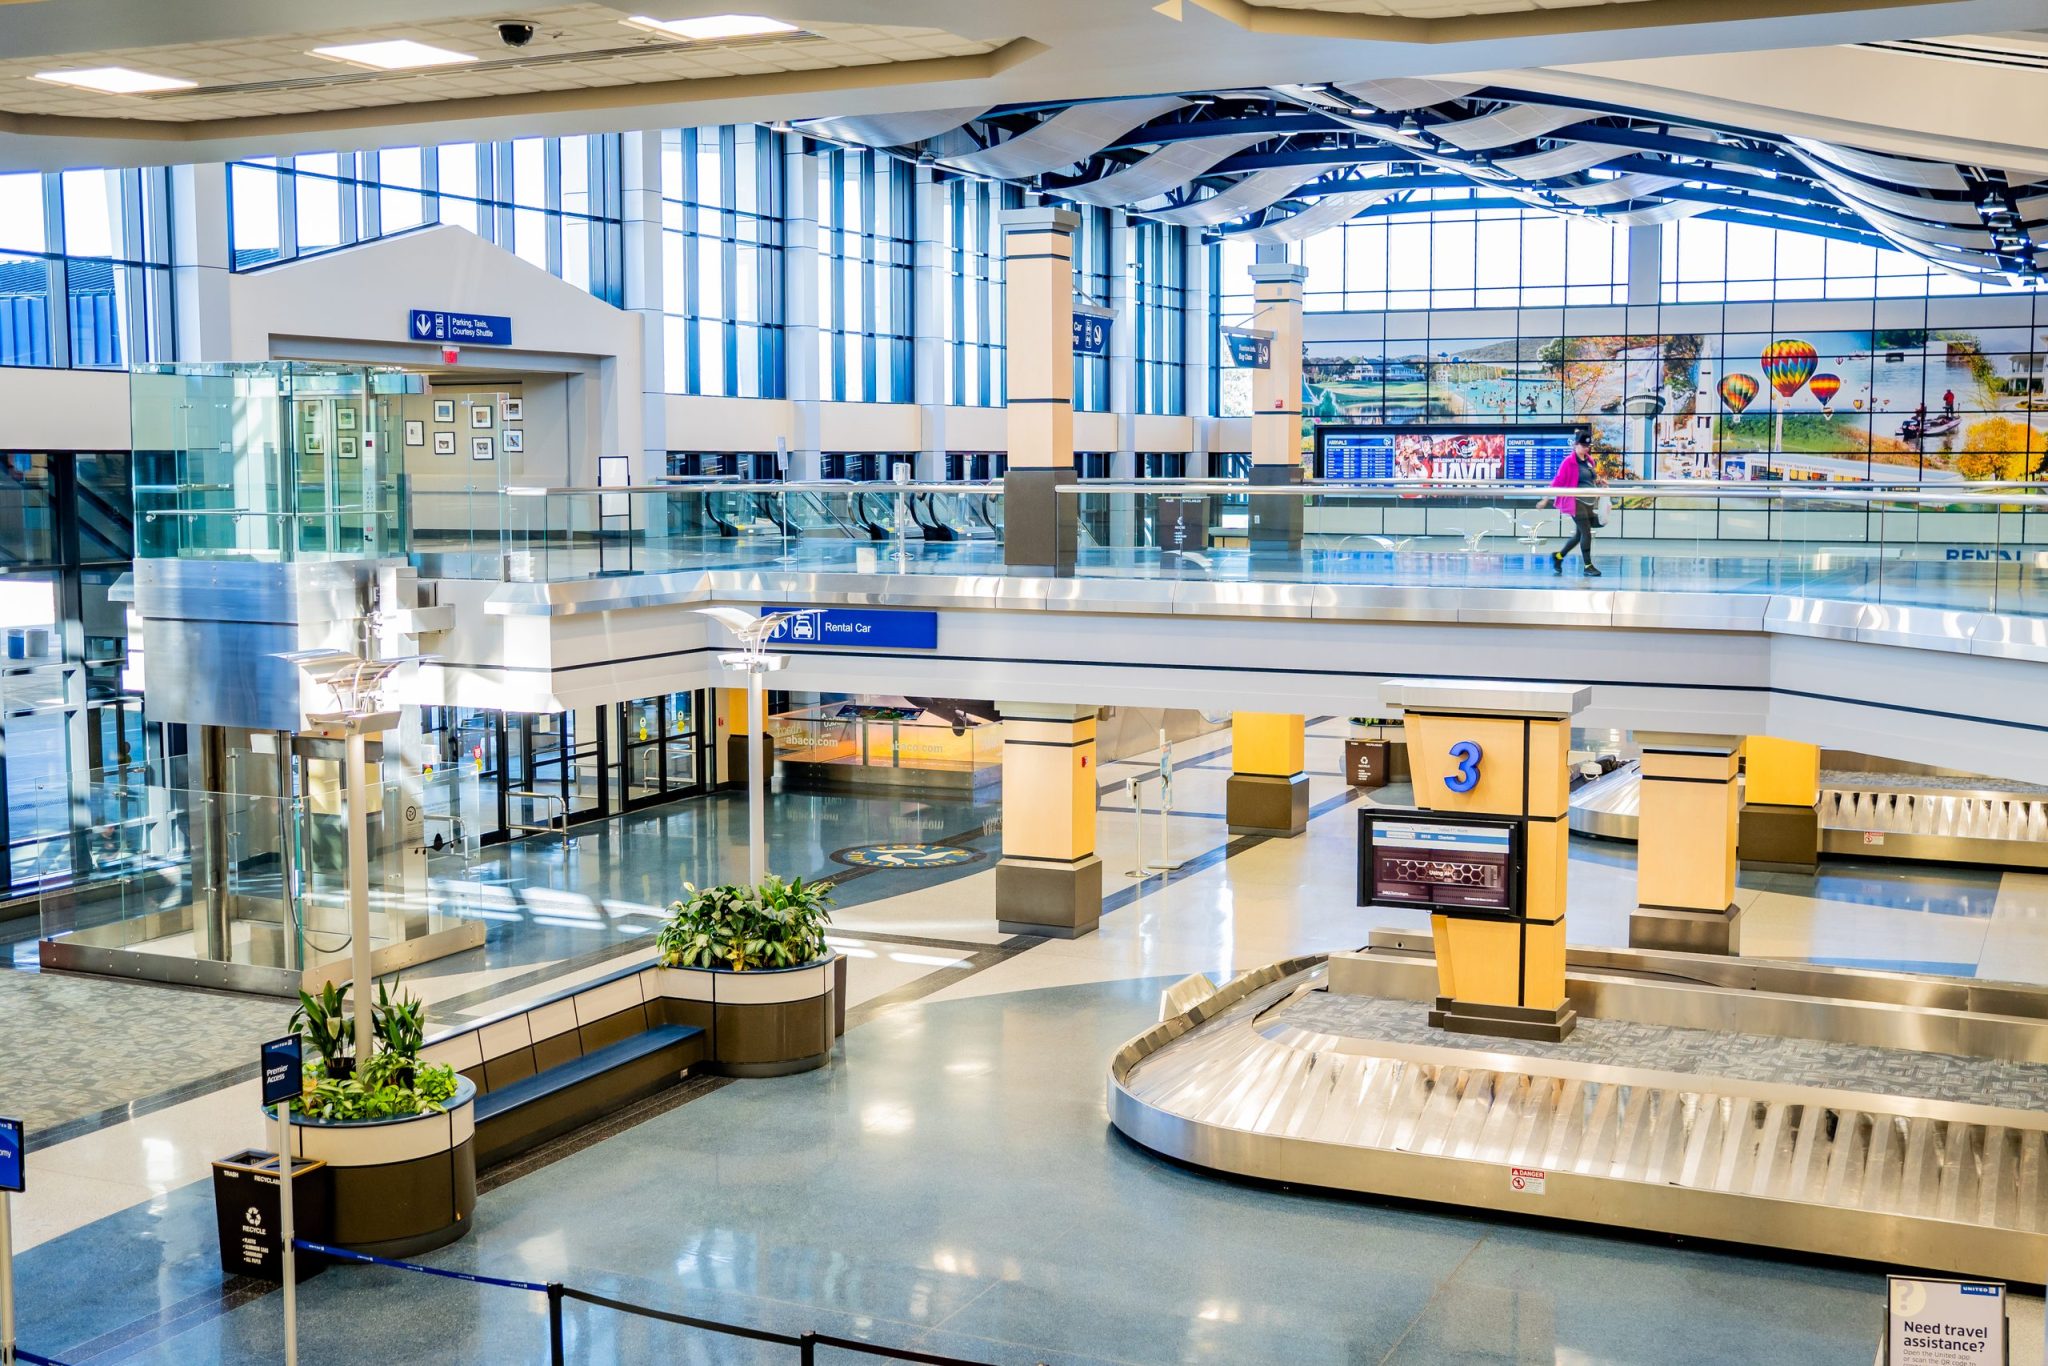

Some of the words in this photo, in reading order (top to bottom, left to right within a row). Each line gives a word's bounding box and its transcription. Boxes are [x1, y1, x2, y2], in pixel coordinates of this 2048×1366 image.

[452, 318, 473, 328] Parking,
[474, 319, 488, 328] Taxis,
[1073, 321, 1083, 332] Car
[452, 328, 475, 337] Courtesy
[476, 329, 494, 337] Shuttle
[1432, 463, 1502, 484] HAVOC
[825, 622, 852, 632] Rental
[855, 623, 871, 632] Car
[786, 735, 838, 747] abaco.com
[1444, 740, 1484, 793] 3
[266, 1064, 288, 1076] Premier
[267, 1073, 285, 1084] Access
[224, 1170, 239, 1178] TRASH
[1520, 1170, 1544, 1178] DANGER
[242, 1225, 266, 1235] RECYCLE
[1904, 1321, 1941, 1334] Need
[1945, 1325, 1988, 1338] travel
[1904, 1336, 1985, 1352] assistance?
